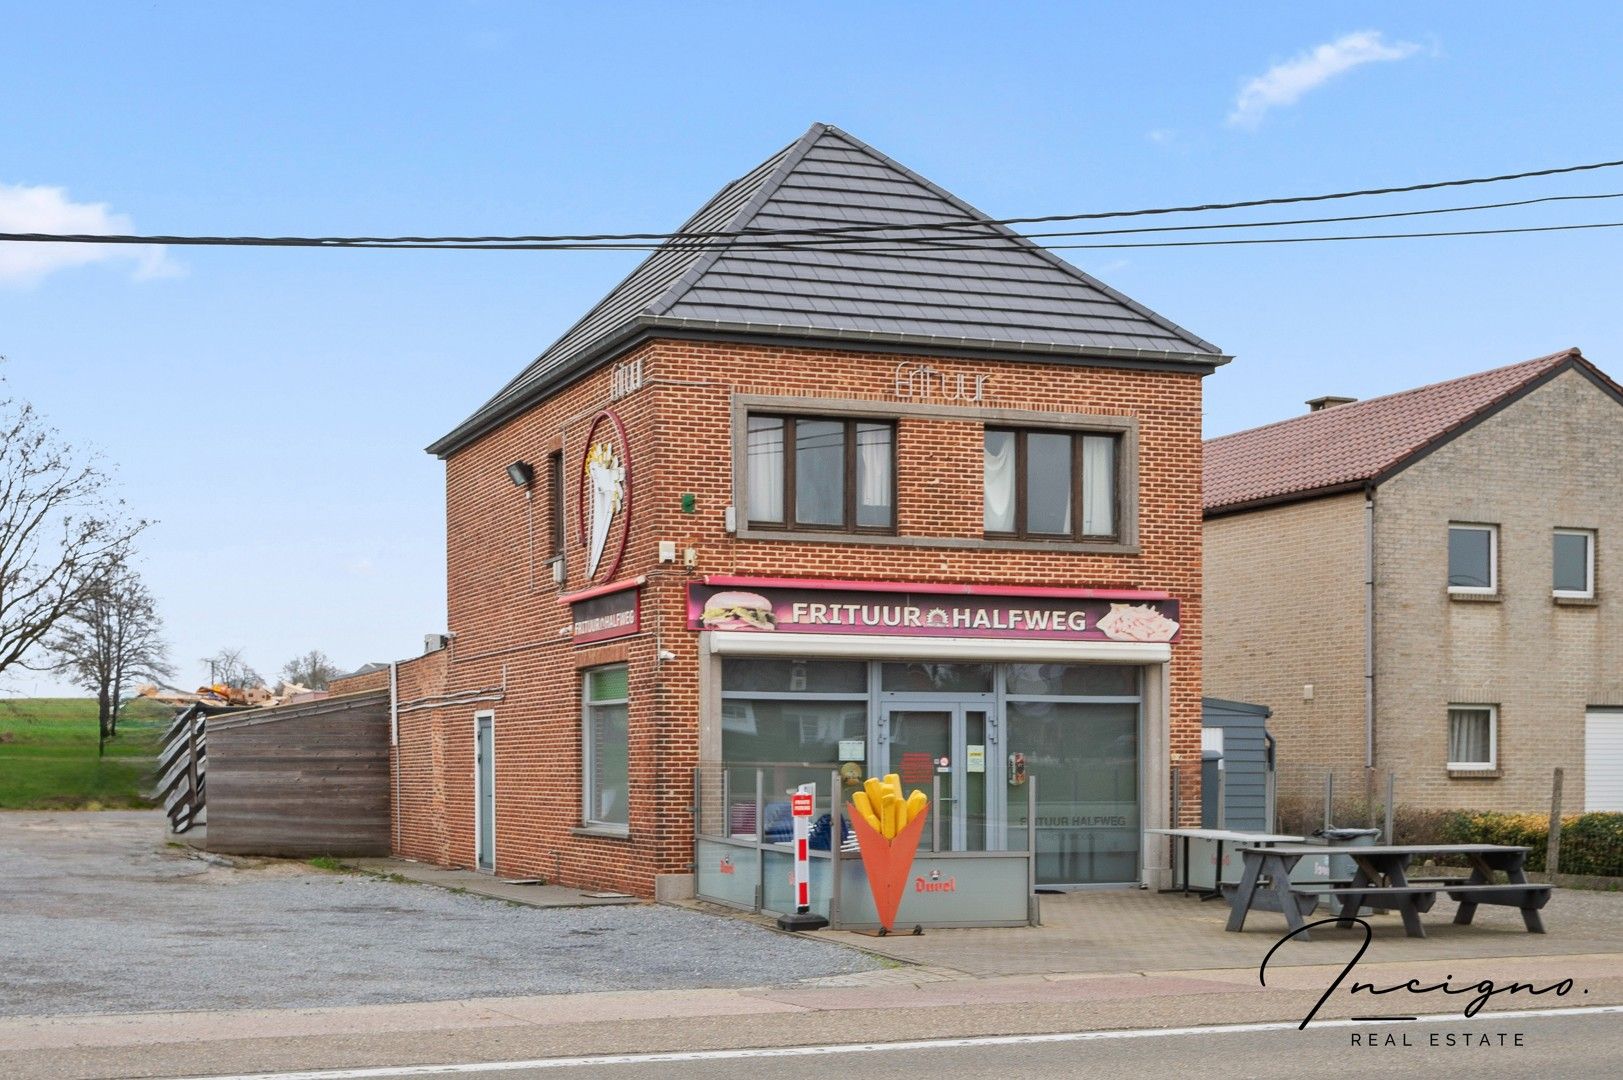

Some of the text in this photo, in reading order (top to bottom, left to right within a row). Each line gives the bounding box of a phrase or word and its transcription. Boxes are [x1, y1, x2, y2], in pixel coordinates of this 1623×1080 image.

[791, 603, 1086, 631] FRITUUR HALFWEG
[1071, 816, 1127, 827] HALFWEG
